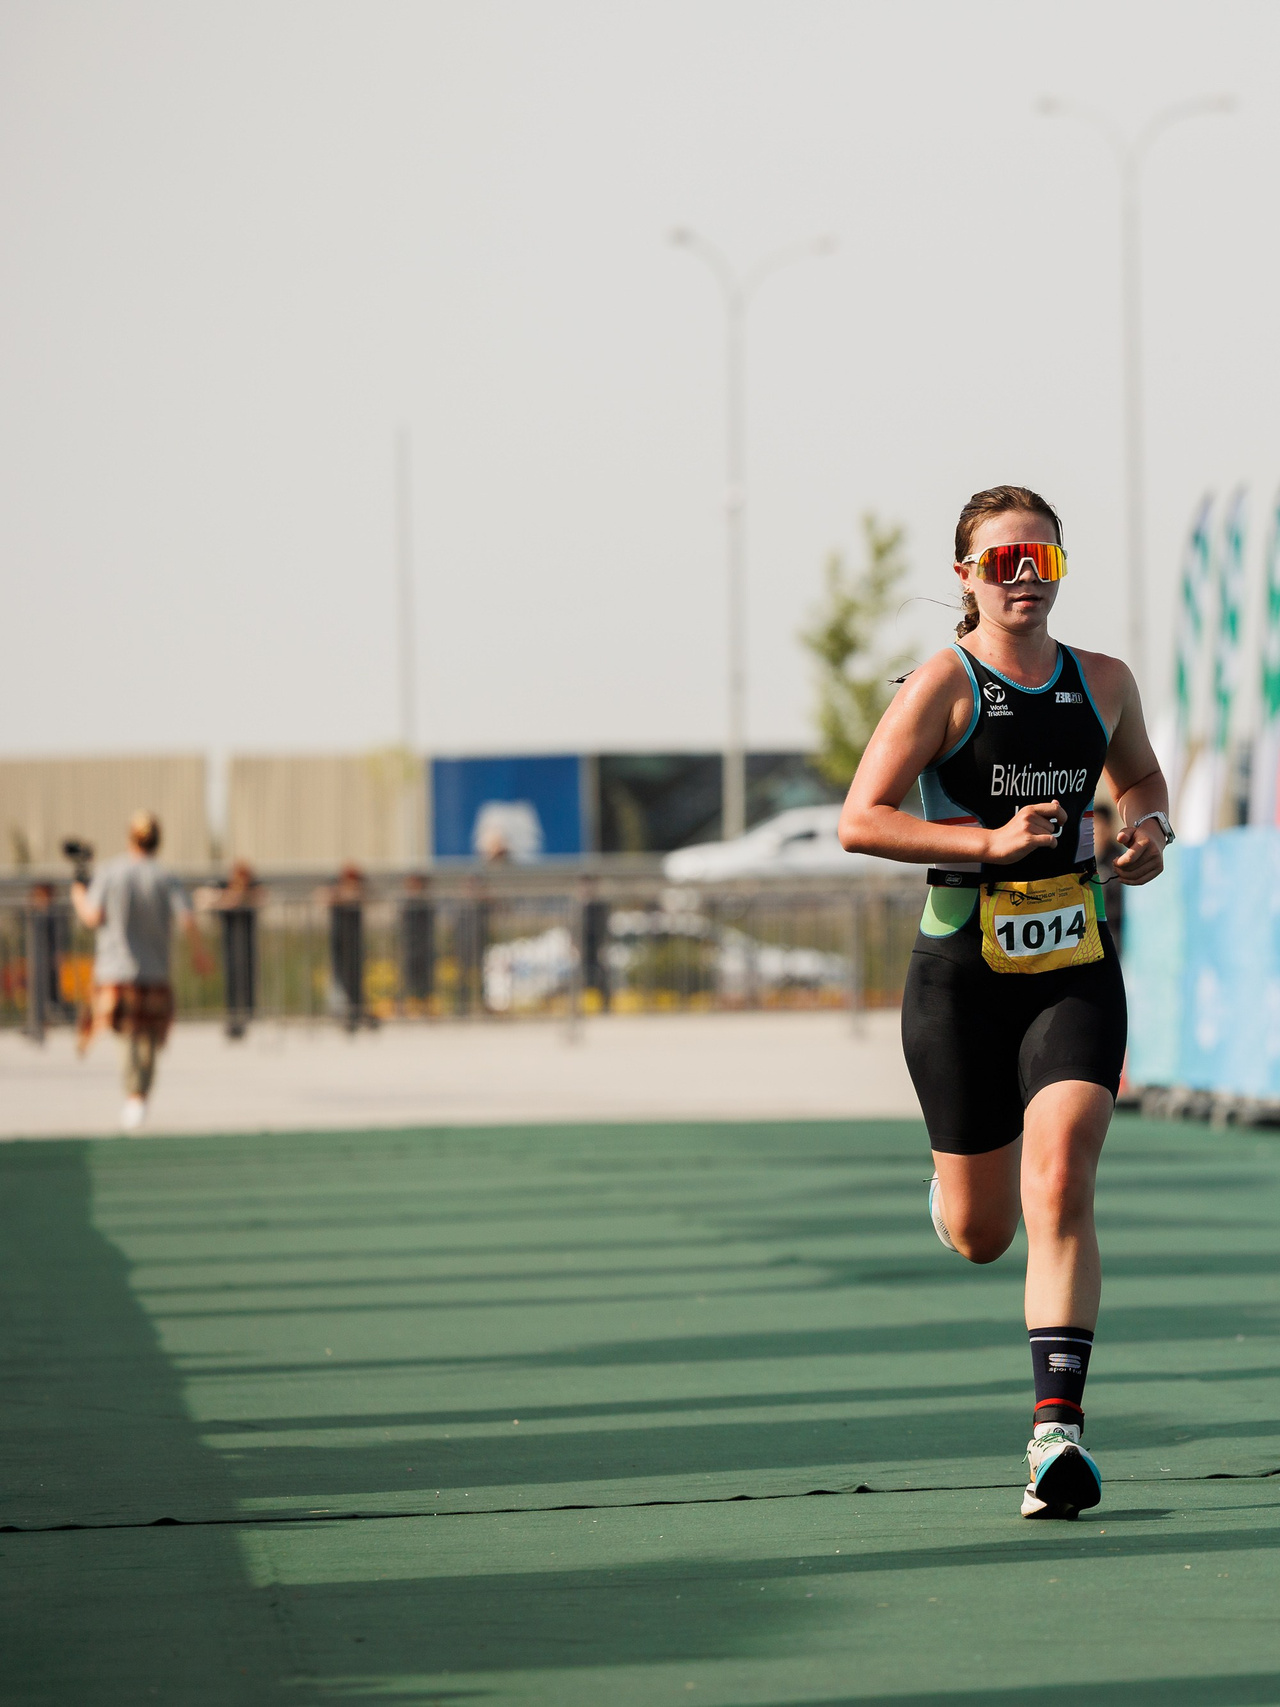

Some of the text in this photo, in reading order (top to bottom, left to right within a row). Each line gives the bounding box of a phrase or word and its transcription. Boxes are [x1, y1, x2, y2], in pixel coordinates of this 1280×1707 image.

[987, 710, 1014, 718] Triathlon
[990, 761, 1087, 796] Biktimirova
[997, 910, 1086, 950] 1014
